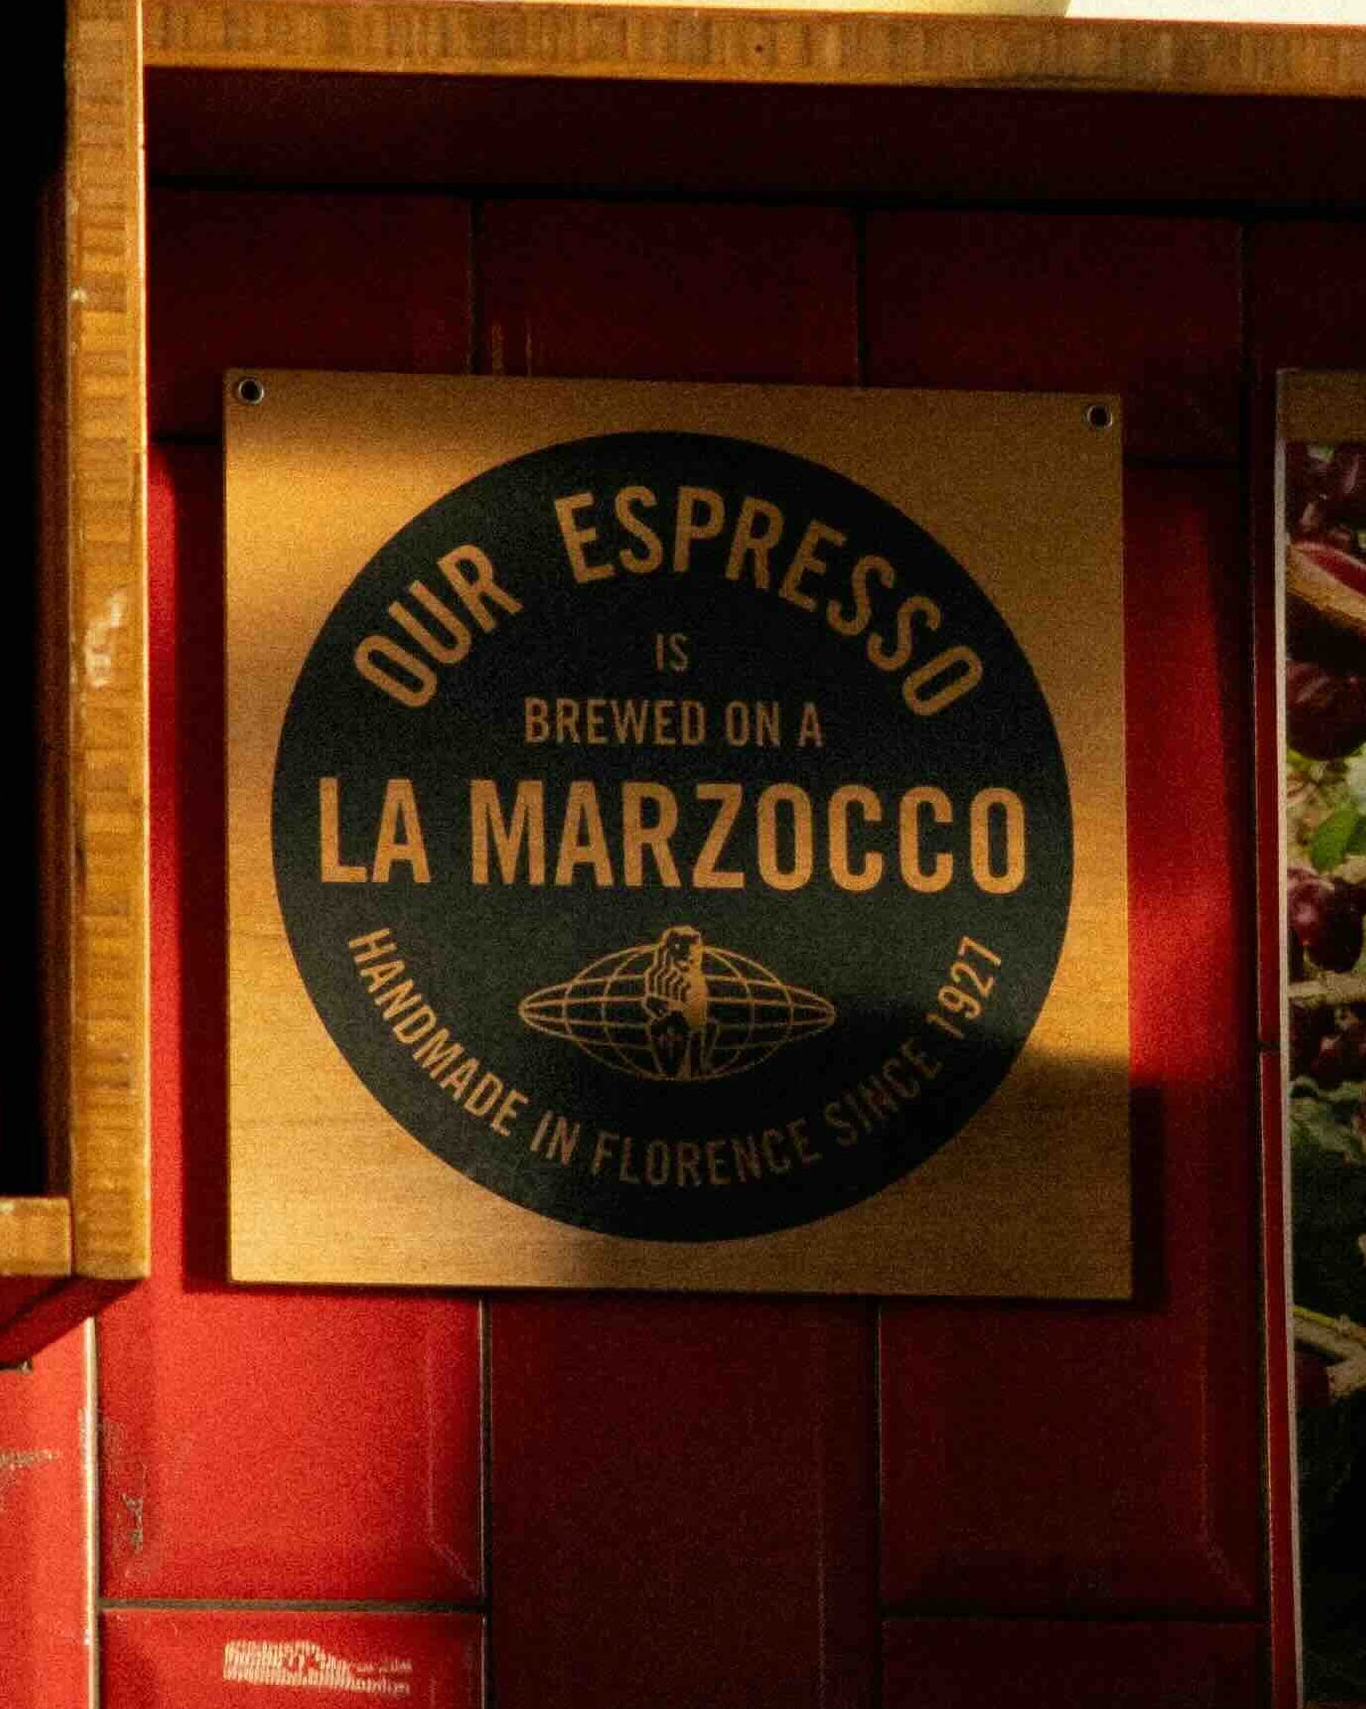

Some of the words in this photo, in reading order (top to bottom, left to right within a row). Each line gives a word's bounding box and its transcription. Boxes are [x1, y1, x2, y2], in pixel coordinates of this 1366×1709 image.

[354, 544, 523, 707] OUR
[554, 485, 983, 717] ESPRESSO
[654, 632, 690, 673] IS
[524, 696, 707, 745] BREWED
[725, 700, 781, 747] ON
[798, 702, 824, 748] A
[318, 777, 431, 884] LA
[469, 778, 1026, 894] MARZOCCO
[347, 928, 530, 1137] HANDMADE
[529, 1109, 582, 1168] IN
[590, 1116, 825, 1188] FLORENCE
[825, 1037, 945, 1150] SINCE
[922, 935, 1002, 1041] 1927
